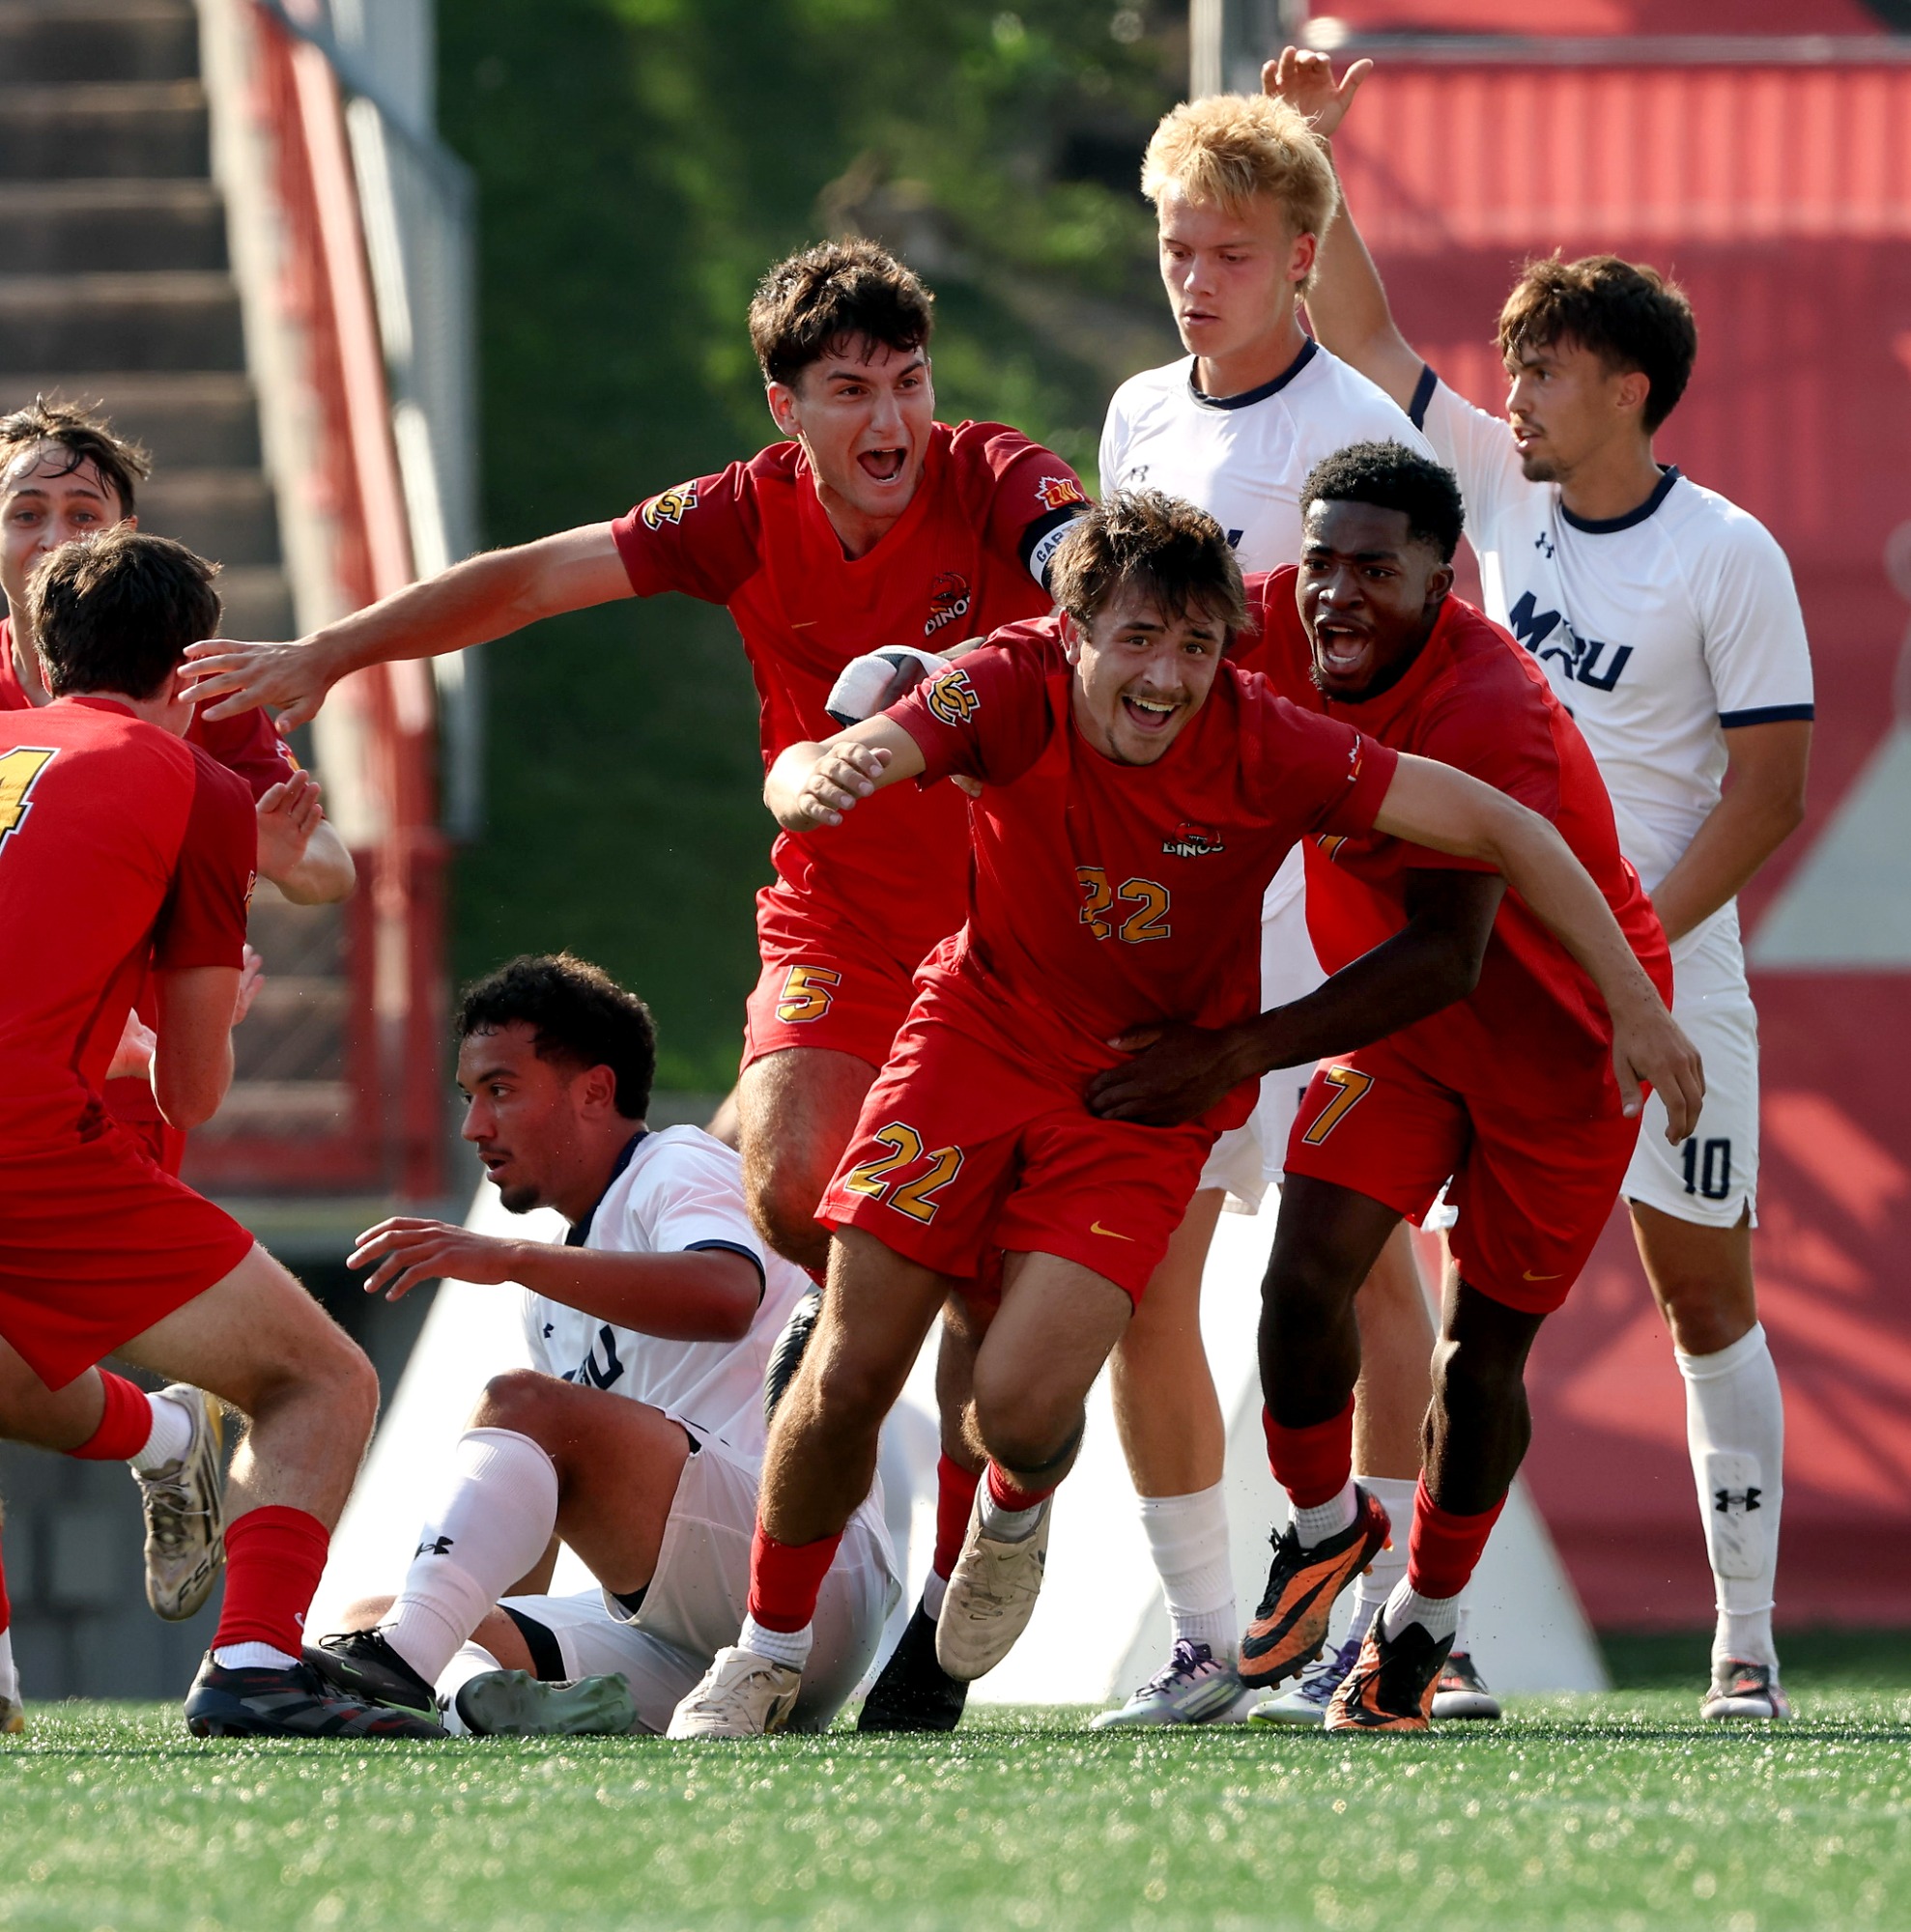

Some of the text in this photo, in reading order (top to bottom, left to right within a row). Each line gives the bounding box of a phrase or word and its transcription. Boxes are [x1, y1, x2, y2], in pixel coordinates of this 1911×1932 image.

[925, 595, 971, 637] DINO
[775, 964, 841, 1024] 5
[1301, 1065, 1375, 1147] 7
[843, 1121, 965, 1226] 22
[1681, 1137, 1731, 1201] 10
